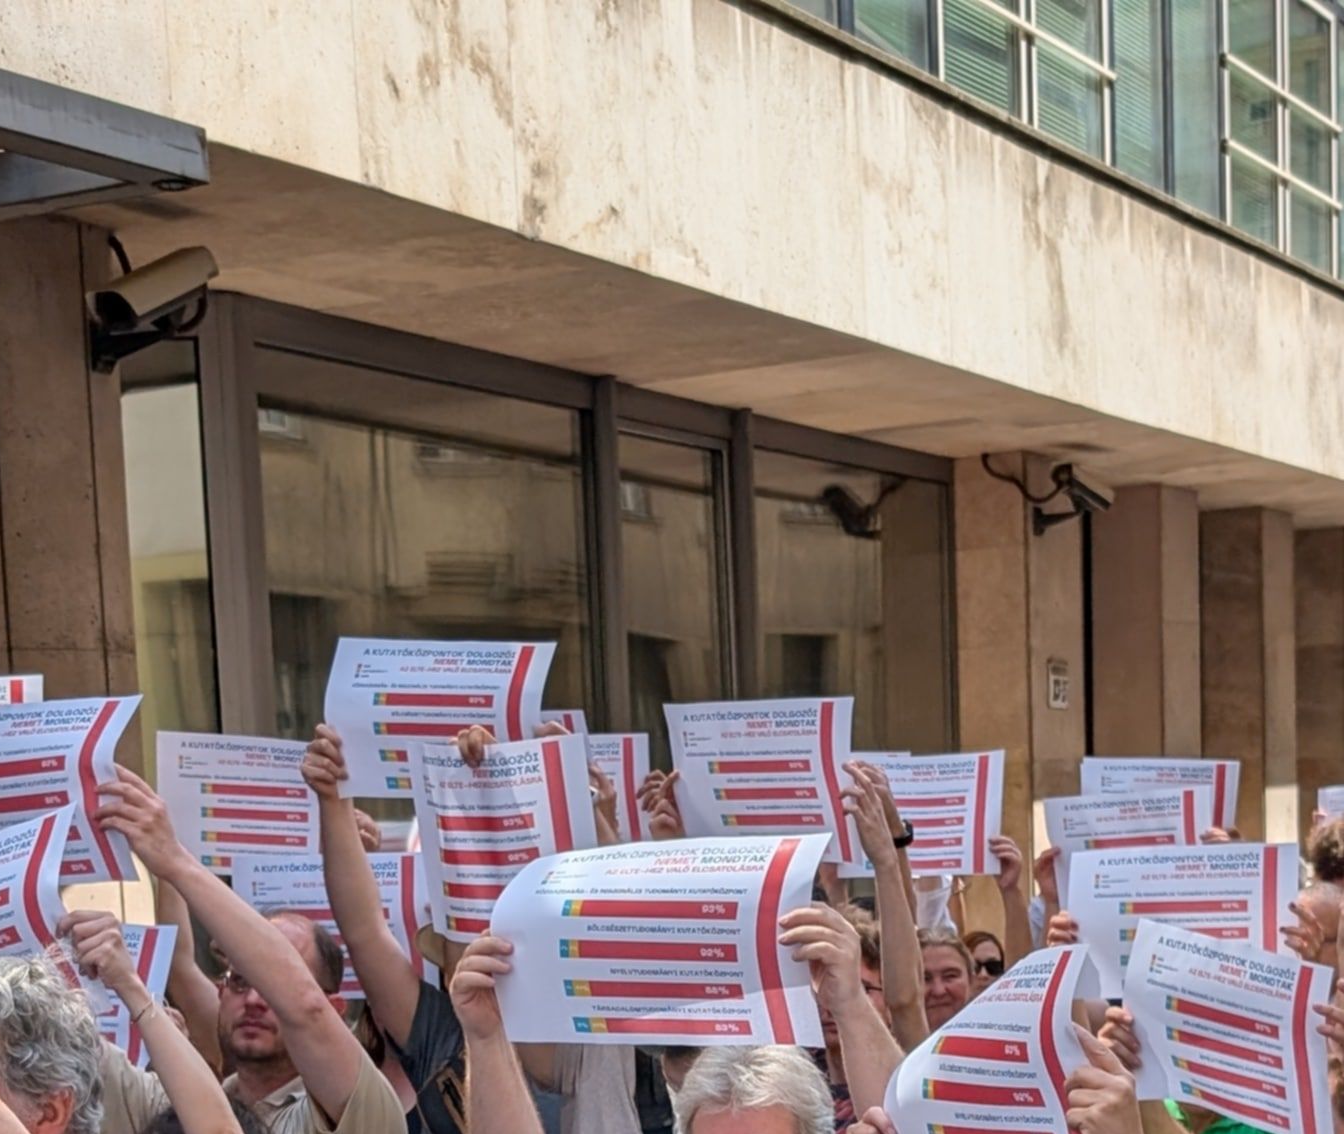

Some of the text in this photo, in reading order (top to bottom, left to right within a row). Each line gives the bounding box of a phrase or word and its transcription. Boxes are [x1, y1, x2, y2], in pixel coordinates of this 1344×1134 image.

[683, 714, 689, 722] A
[747, 719, 817, 729] NEMET MONDTAK
[562, 845, 774, 864] A KUTATÓKÖZPONTOK DOLGOZÓI
[654, 854, 769, 865] NEMET MONDTAK
[666, 864, 690, 873] VALÓ
[1210, 862, 1259, 870] MONDTAK
[702, 904, 725, 914] 93%
[1158, 937, 1164, 945] A
[700, 948, 724, 958] 92%
[1219, 964, 1294, 991] NEMET MONDTAK
